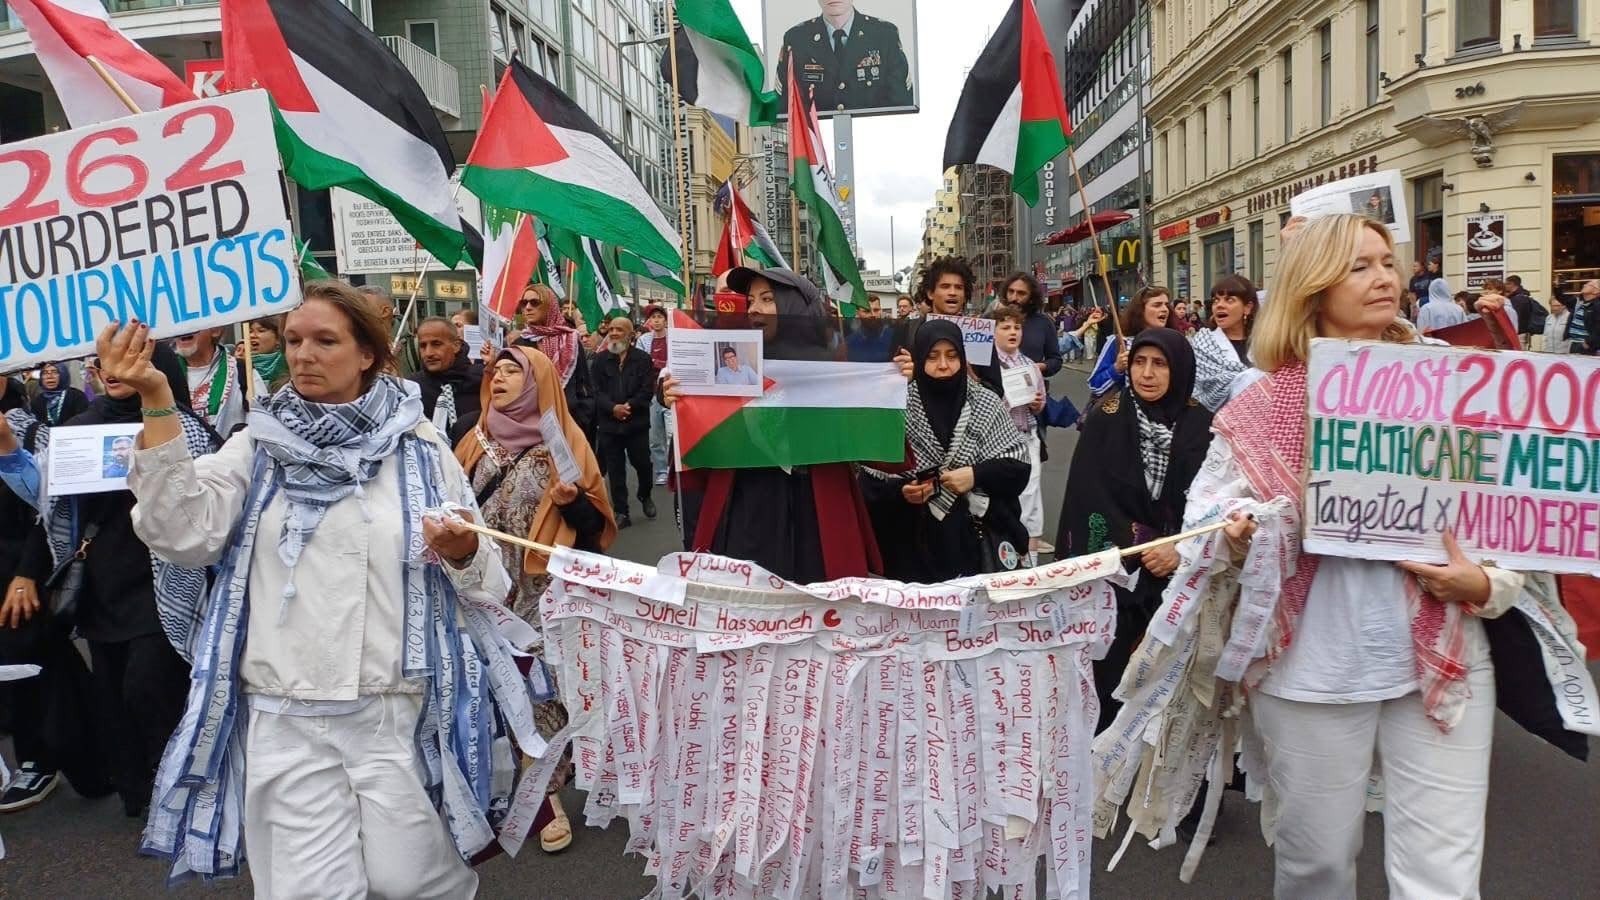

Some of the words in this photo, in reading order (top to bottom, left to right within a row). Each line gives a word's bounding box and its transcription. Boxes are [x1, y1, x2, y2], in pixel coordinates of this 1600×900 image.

[1455, 82, 1486, 99] 206
[0, 104, 246, 228] 262
[763, 143, 774, 184] CHARLIE
[0, 178, 249, 286] MURDERED
[766, 186, 777, 245] HECKPOINT
[1468, 254, 1503, 262] KAFFEE
[0, 227, 291, 357] JOURNALISTS
[1316, 346, 1451, 422] almost
[1311, 417, 1502, 485] HEALTHCARE
[1309, 480, 1428, 542] Targeted
[1452, 490, 1600, 558] MURDERE
[636, 597, 698, 628] Suheil
[946, 629, 999, 652] Basel
[464, 651, 481, 689] Majed
[694, 652, 715, 682] Amir
[782, 658, 808, 716] Rasha
[807, 658, 823, 689] Maria
[880, 655, 896, 691] Khalil
[688, 691, 709, 731] Subhi
[1011, 663, 1033, 727] Toubasi
[875, 701, 895, 759] Mahmoud
[960, 693, 977, 743] Shaath
[684, 742, 702, 776] Abdel
[722, 714, 738, 784] MUSTAFA
[738, 741, 760, 783] Zafer
[779, 724, 801, 777] Salah
[1011, 731, 1038, 801] Haytham
[601, 770, 618, 784] Ali
[874, 769, 893, 802] Khalil
[962, 752, 977, 795] al-Din
[682, 783, 698, 810] Aziz
[678, 821, 695, 842] Abu
[871, 809, 887, 852] Hamdan
[984, 827, 1000, 871] Riham
[1053, 822, 1068, 870] Viola
